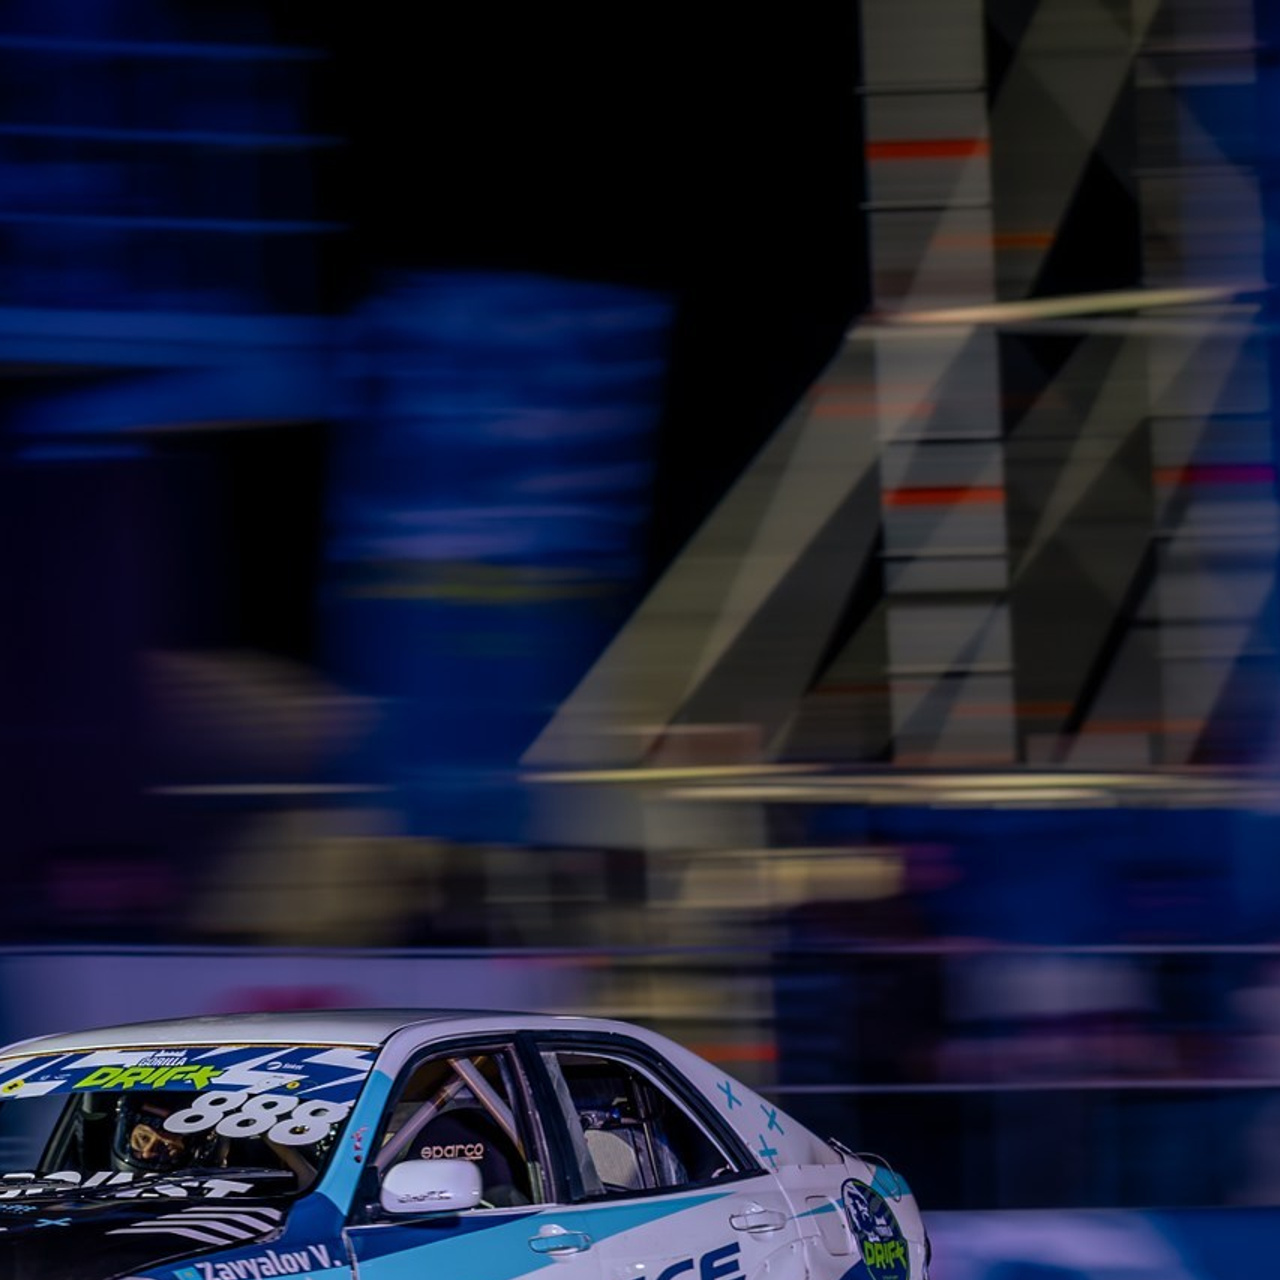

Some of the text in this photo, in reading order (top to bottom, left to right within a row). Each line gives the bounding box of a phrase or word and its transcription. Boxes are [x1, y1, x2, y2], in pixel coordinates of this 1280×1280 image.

[72, 1064, 223, 1091] DRIFT
[163, 1089, 350, 1146] 888
[306, 1244, 342, 1269] V.
